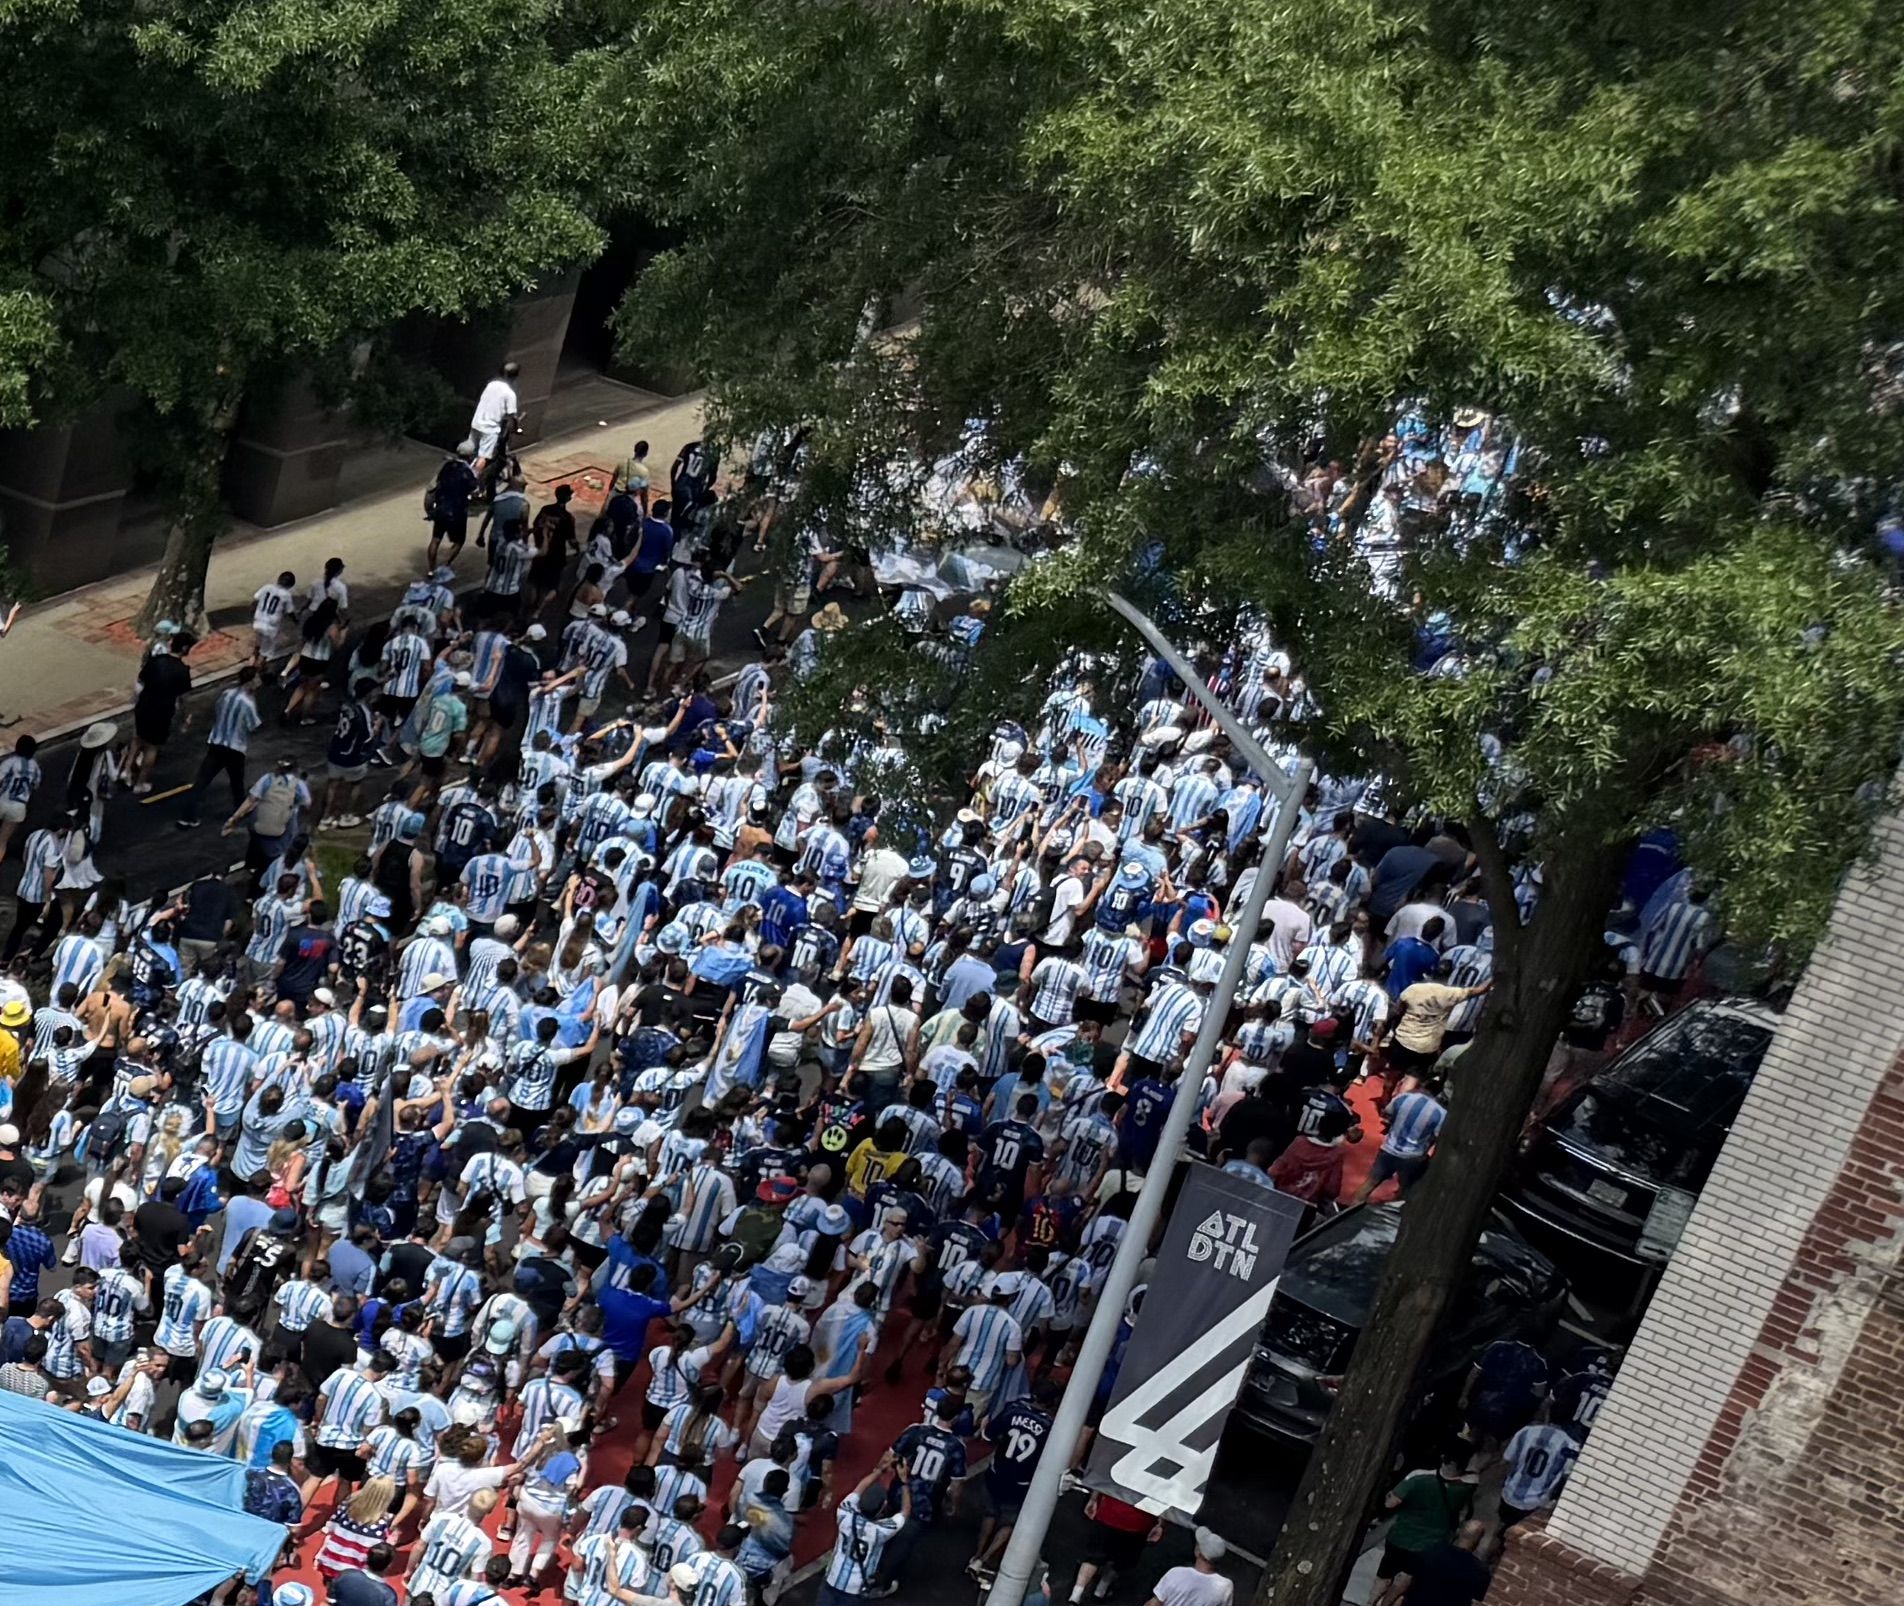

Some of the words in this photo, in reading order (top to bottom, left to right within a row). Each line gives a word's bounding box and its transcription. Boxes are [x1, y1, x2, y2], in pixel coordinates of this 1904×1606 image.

[1125, 797, 1144, 818] 10
[451, 818, 474, 846] 10
[732, 874, 755, 901] 10
[949, 861, 964, 890] 9
[343, 938, 369, 968] 23
[791, 940, 816, 969] 10
[1094, 940, 1112, 967] 10
[1298, 1104, 1324, 1134] 10
[993, 1139, 1019, 1169] 10
[864, 1159, 884, 1183] 10
[1196, 1209, 1259, 1254] ATL
[938, 1239, 967, 1269] 10
[1187, 1232, 1256, 1281] DTN
[97, 1286, 119, 1317] 10
[762, 1325, 787, 1356] 10
[1005, 1429, 1037, 1462] 19
[914, 1444, 943, 1480] 10
[428, 1542, 462, 1577] 10
